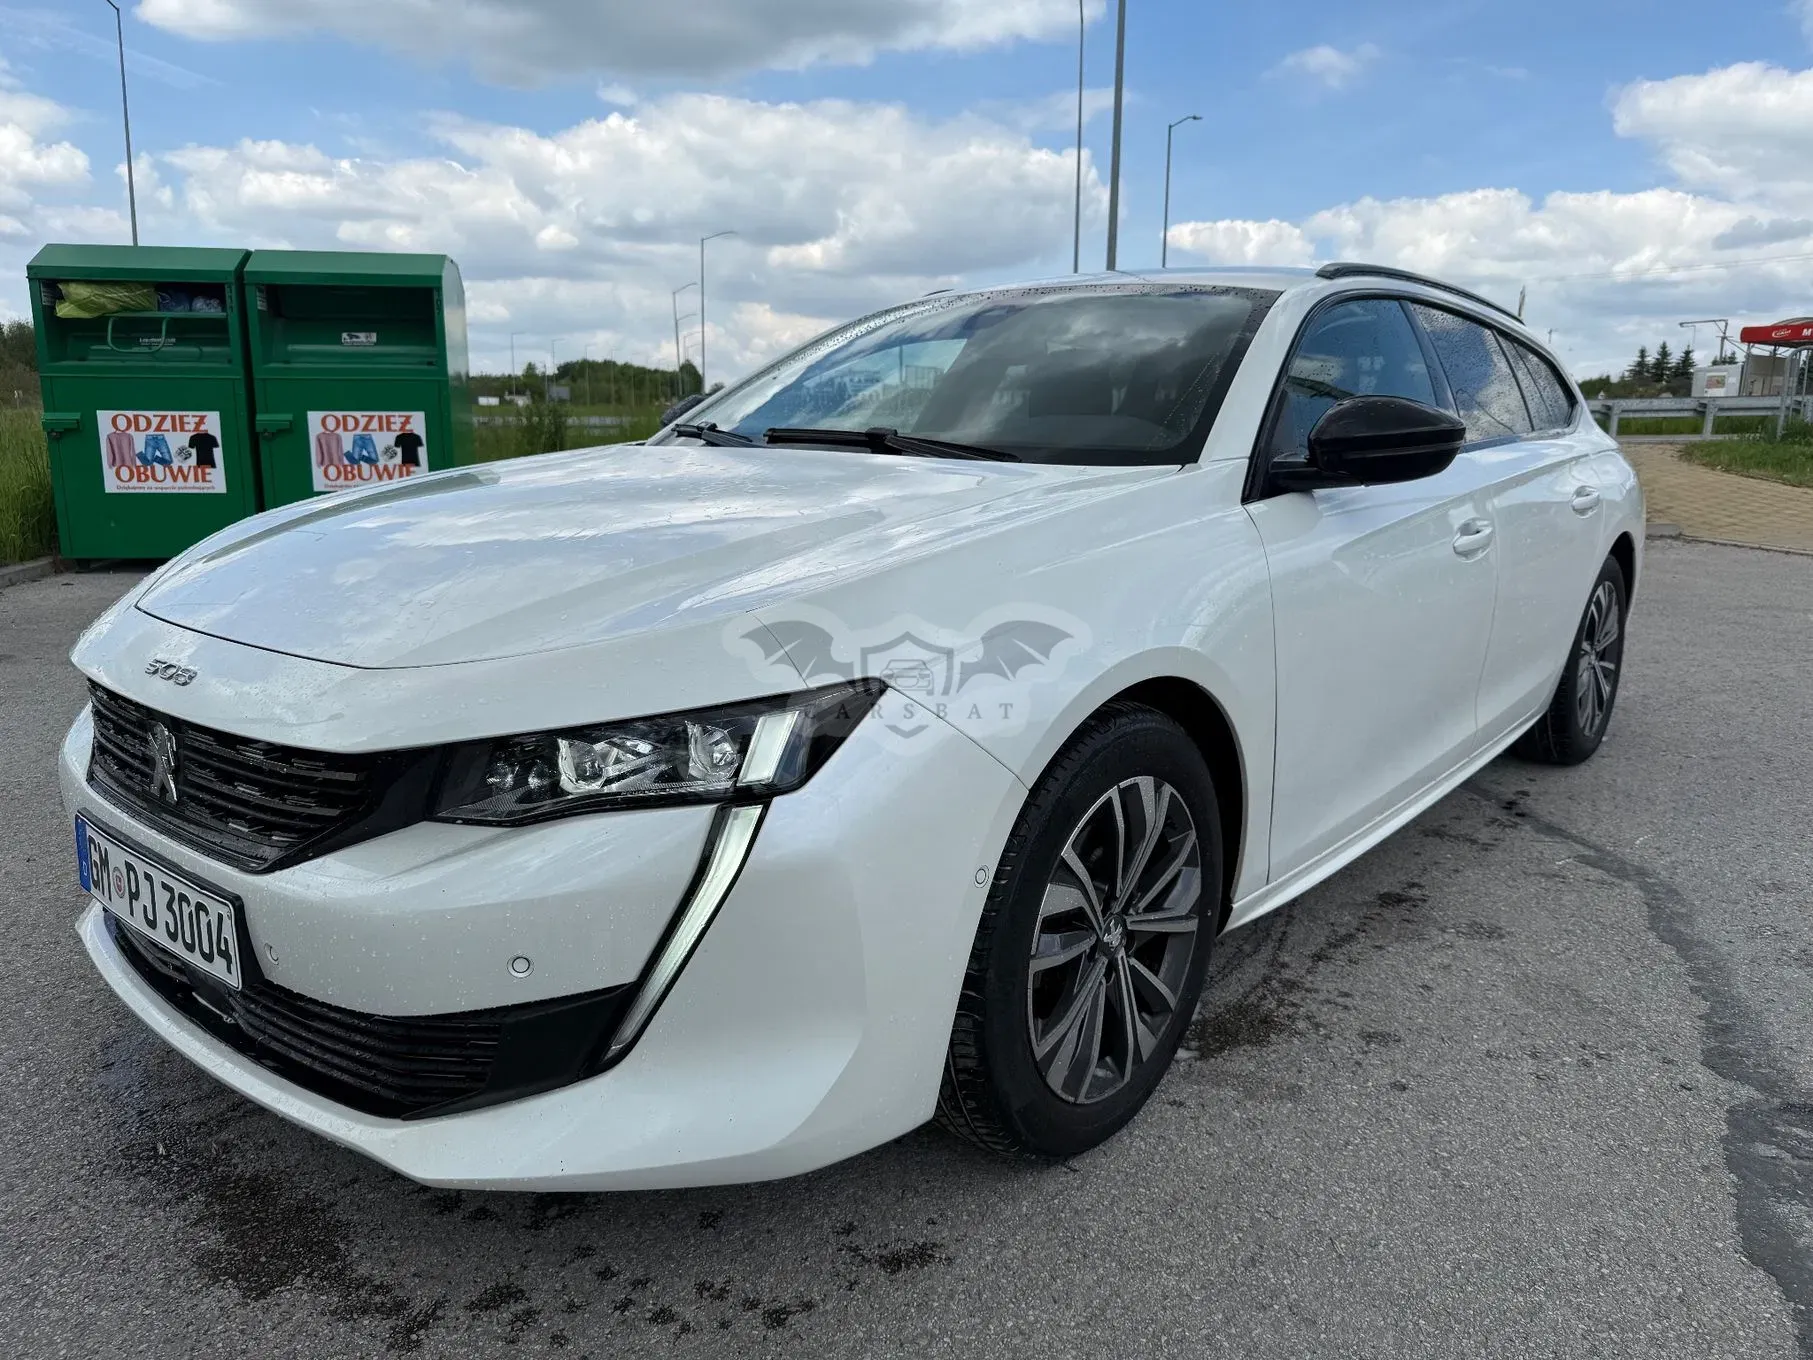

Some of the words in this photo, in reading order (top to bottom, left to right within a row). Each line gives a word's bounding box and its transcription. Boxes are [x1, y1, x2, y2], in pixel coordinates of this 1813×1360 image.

[115, 464, 213, 483] OBUWIE
[145, 658, 198, 687] 508
[87, 834, 112, 902] GM
[125, 860, 157, 931] PJ
[162, 883, 233, 976] 3004
